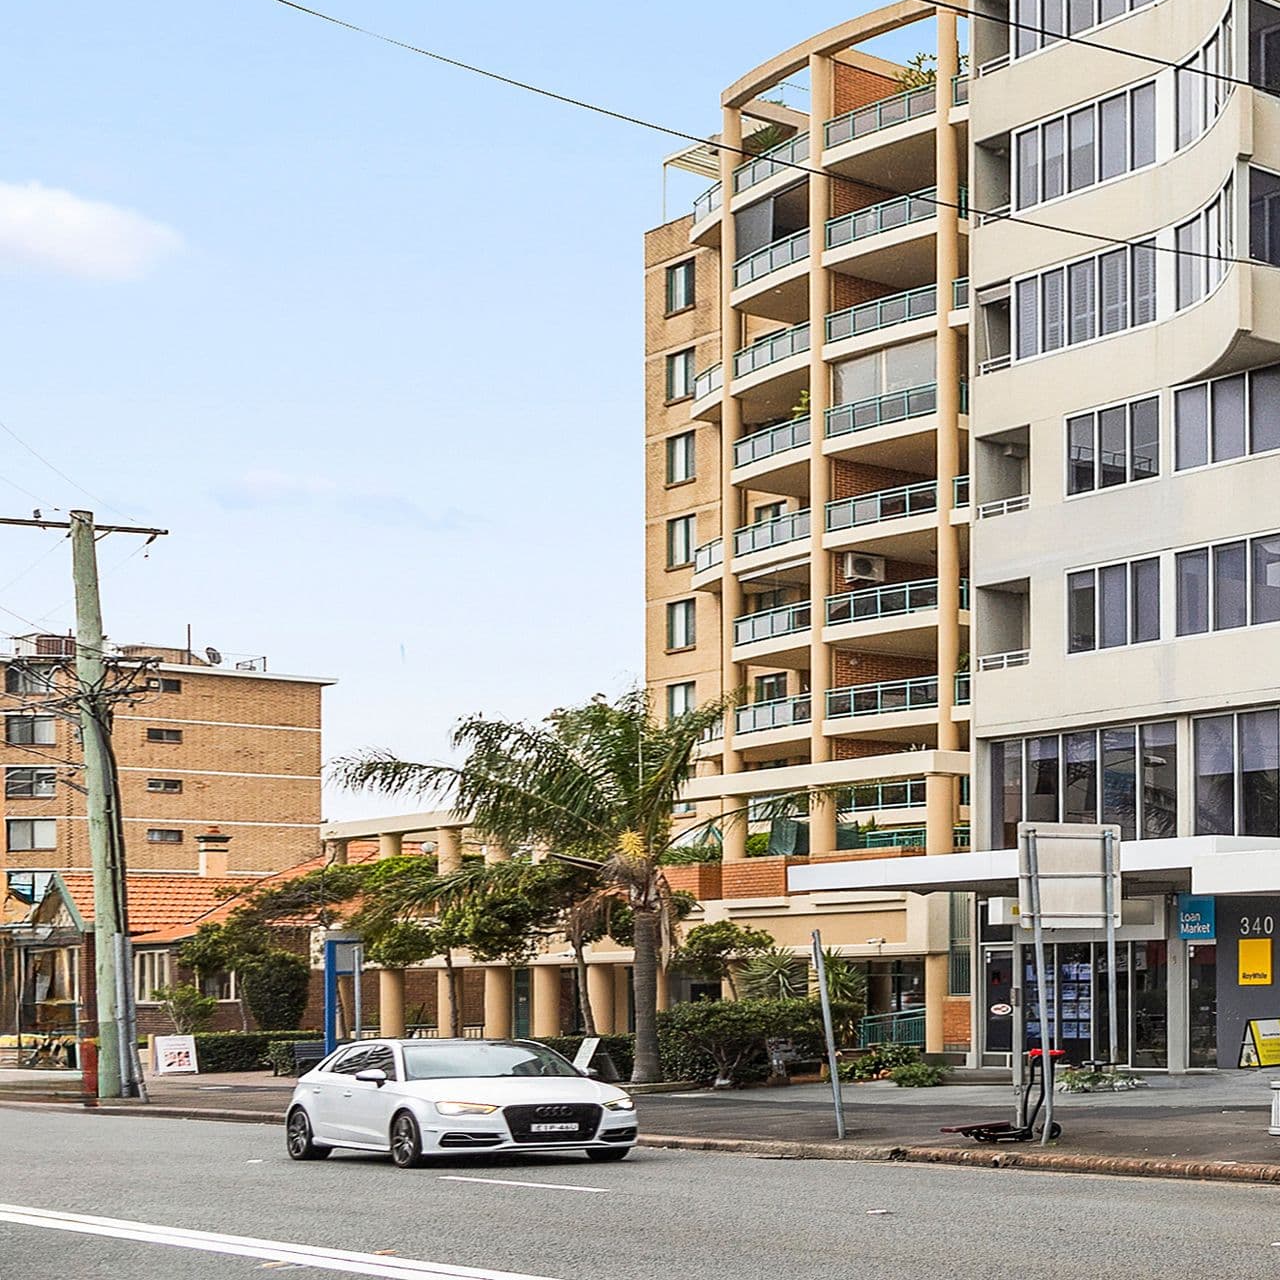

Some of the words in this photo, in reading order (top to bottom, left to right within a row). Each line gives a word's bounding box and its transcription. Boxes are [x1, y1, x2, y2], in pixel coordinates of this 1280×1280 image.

[1180, 912, 1201, 923] Loan
[1180, 923, 1211, 934] Market
[1240, 916, 1274, 935] 340
